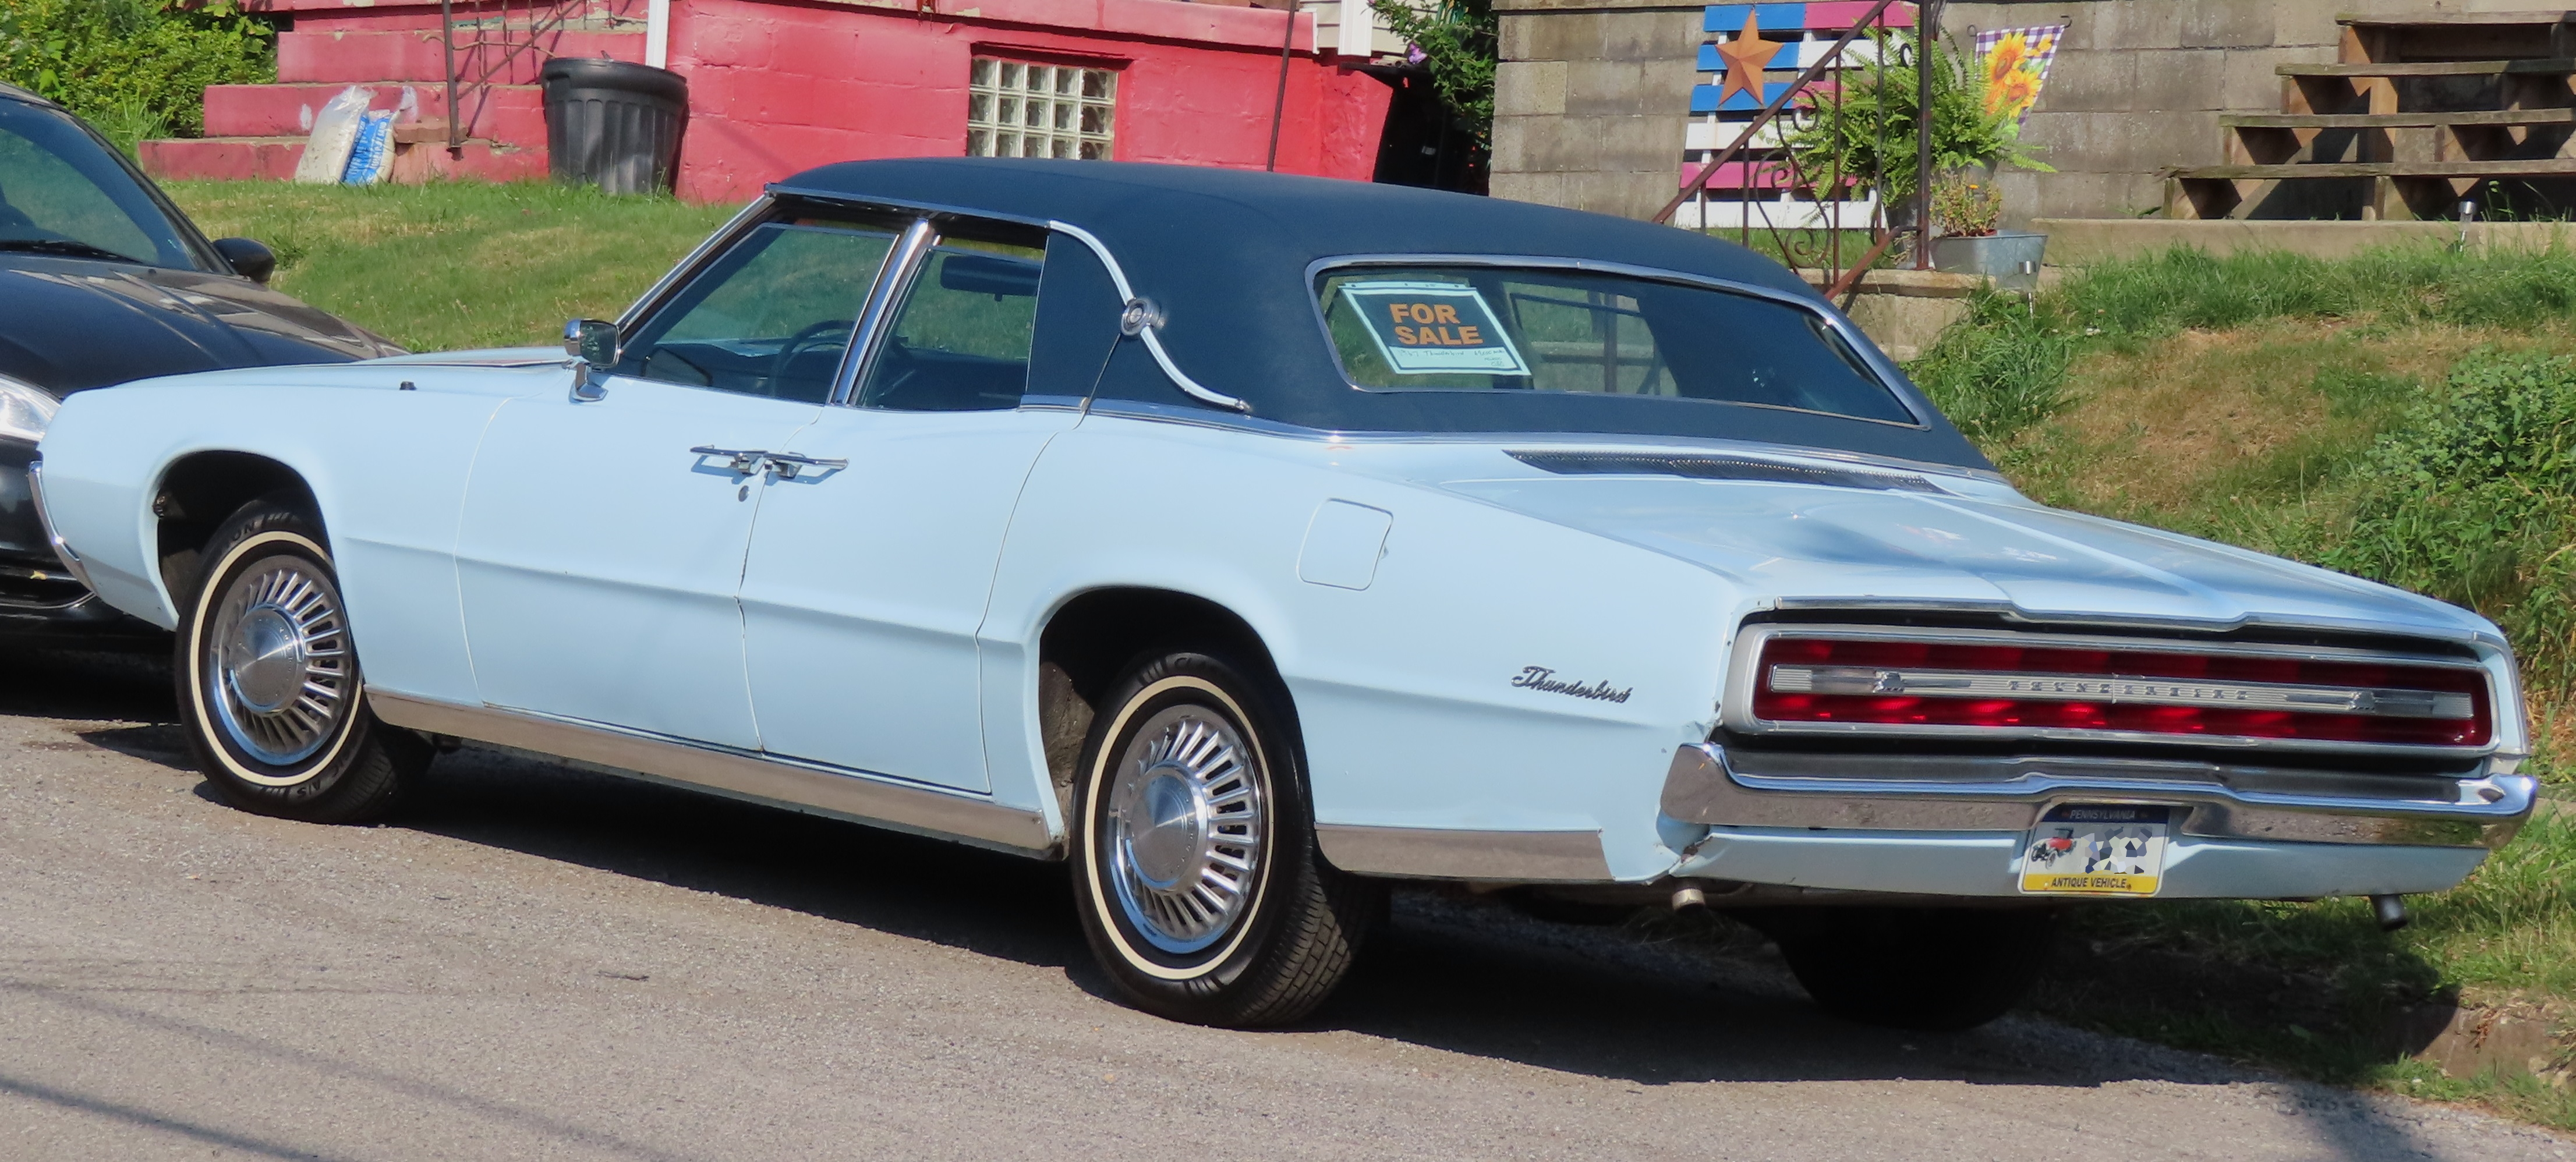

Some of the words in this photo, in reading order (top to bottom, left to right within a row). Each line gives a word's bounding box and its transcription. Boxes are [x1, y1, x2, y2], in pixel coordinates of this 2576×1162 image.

[1389, 303, 1460, 324] FOR
[1395, 326, 1483, 345] SALE
[1511, 666, 1633, 703] Thunderbird
[2007, 680, 2248, 700] THUNDERBIRD
[2070, 810, 2135, 819] PENNSYLVANIA
[2051, 877, 2089, 887] ANTIQUE
[2091, 878, 2128, 888] VEHICLE
